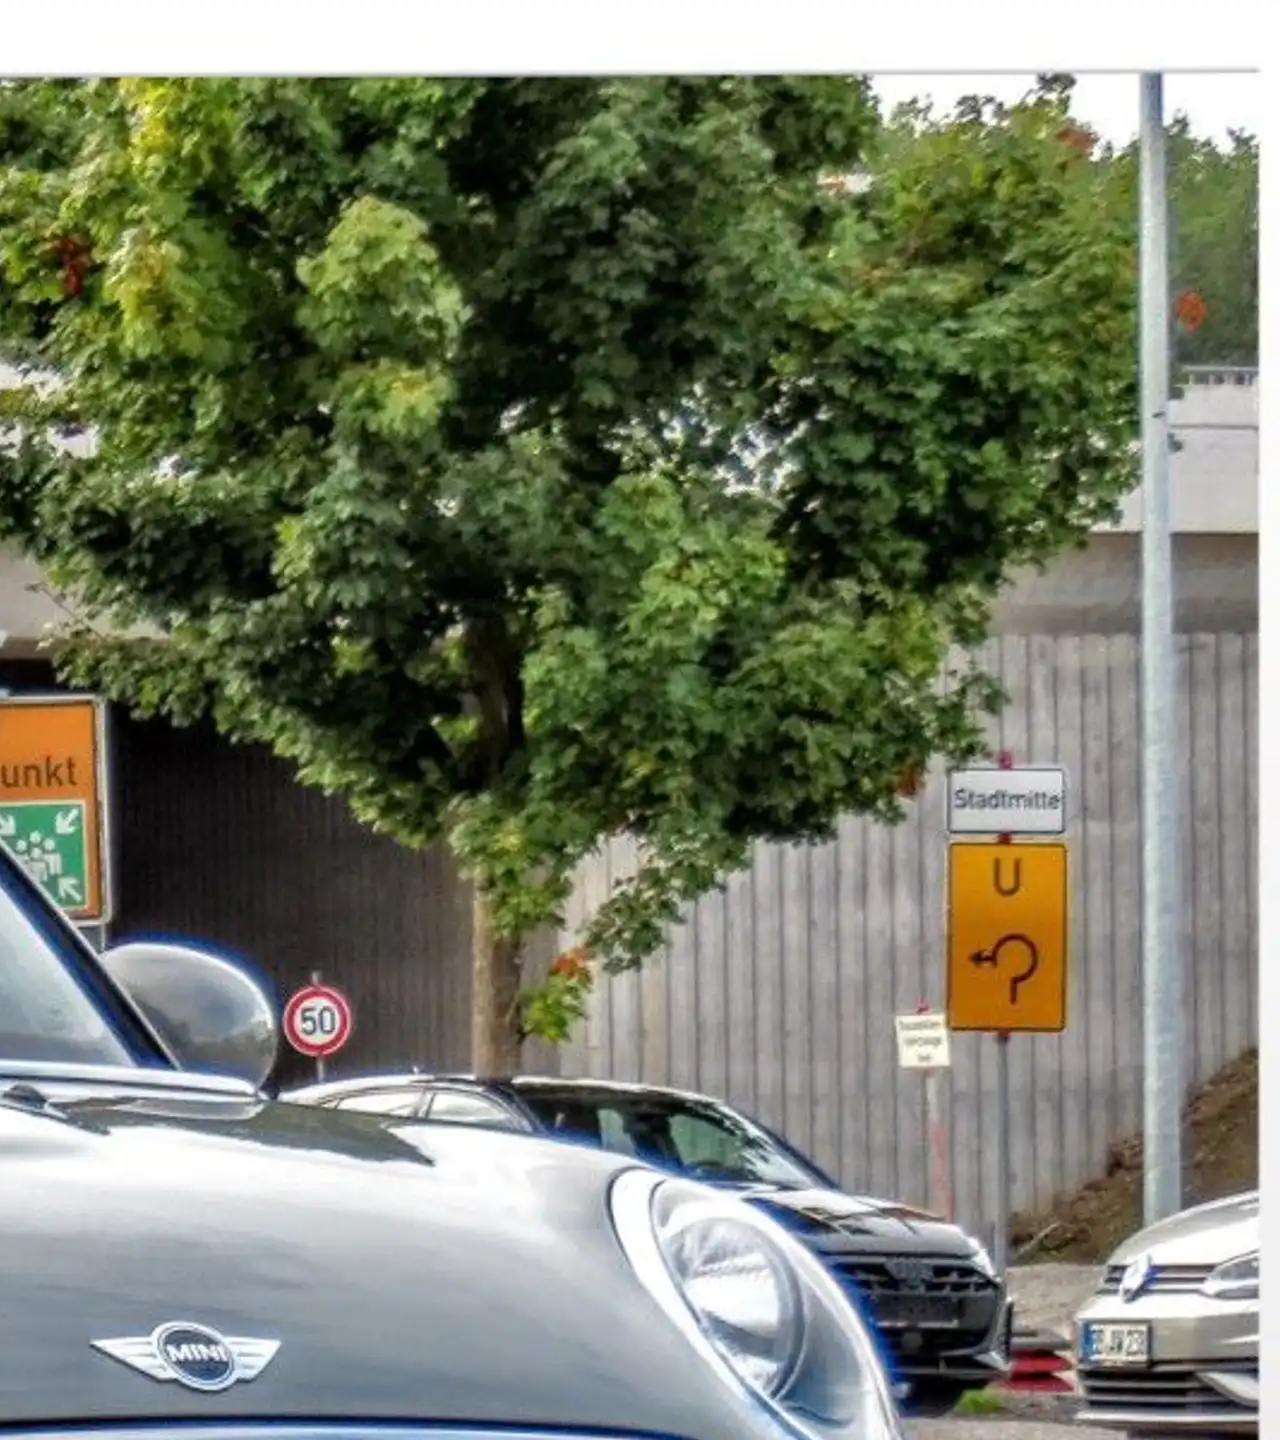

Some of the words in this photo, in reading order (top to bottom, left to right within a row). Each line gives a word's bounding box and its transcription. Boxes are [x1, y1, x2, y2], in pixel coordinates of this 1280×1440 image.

[954, 788, 1061, 810] Stadtmitte
[993, 857, 1022, 897] U
[301, 1005, 336, 1035] 50
[166, 1343, 229, 1363] MINI
